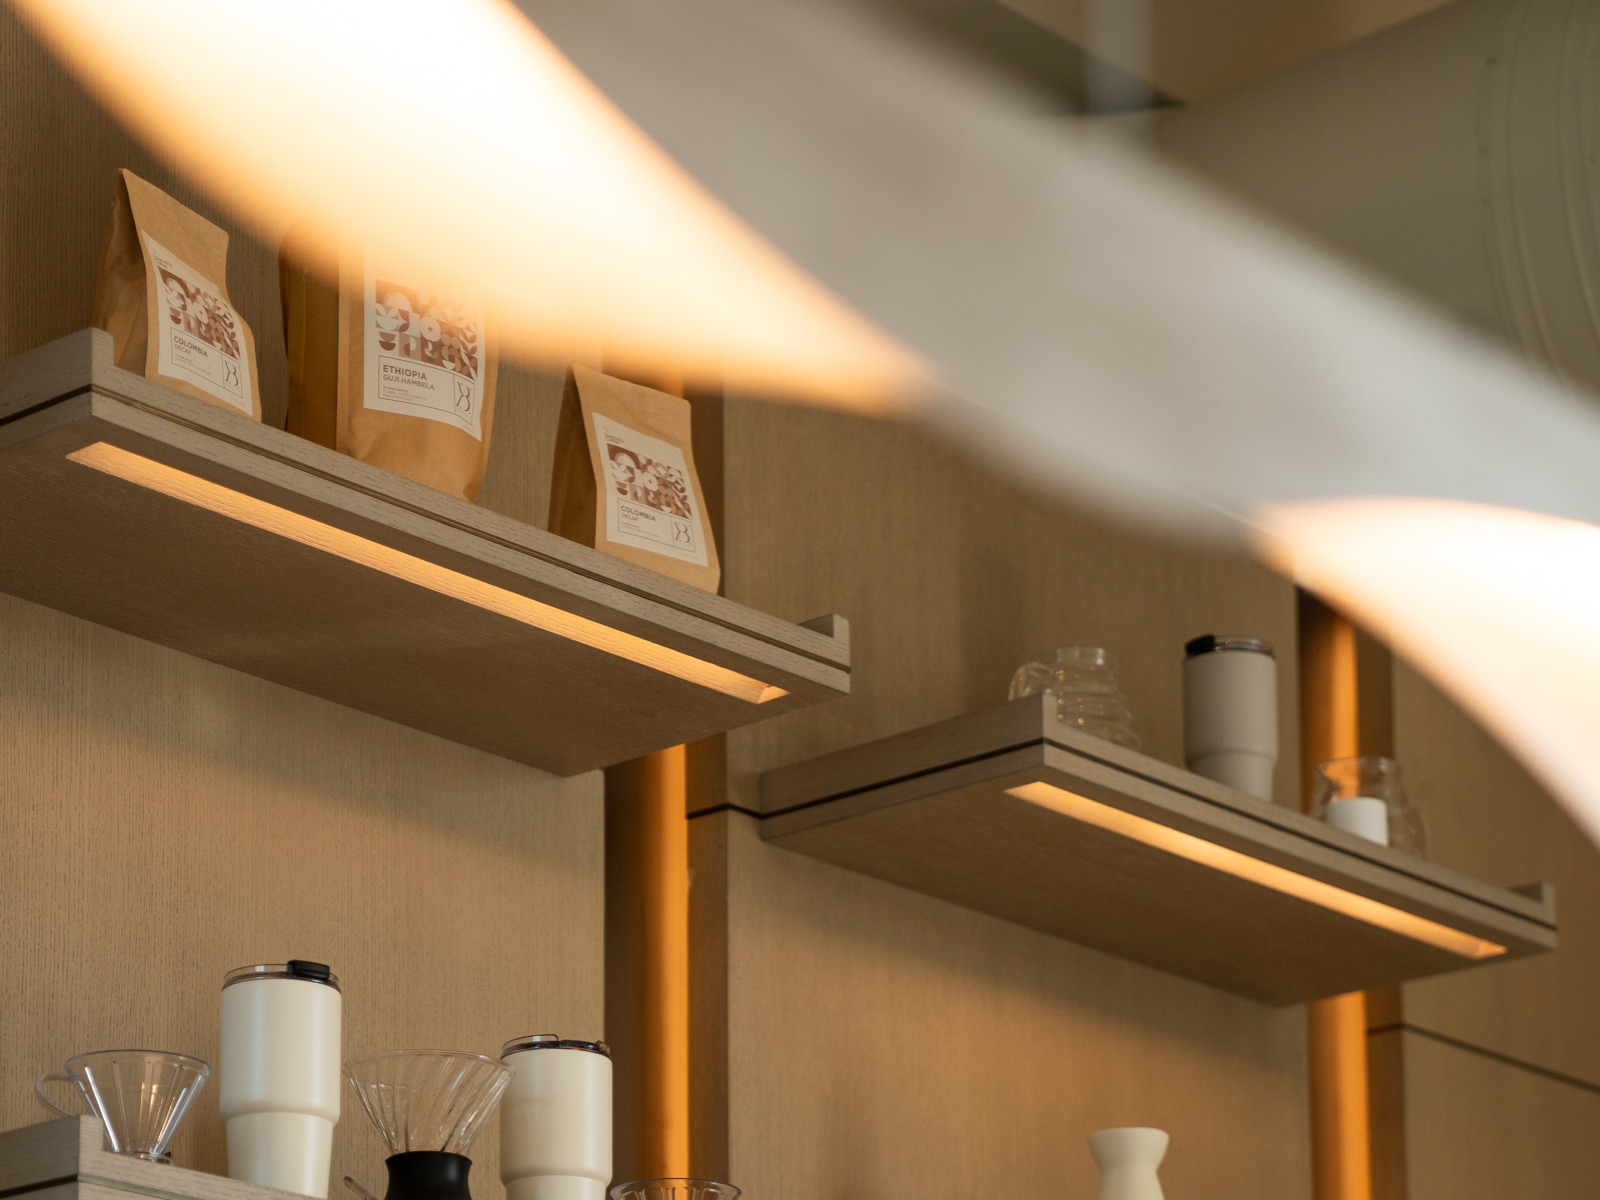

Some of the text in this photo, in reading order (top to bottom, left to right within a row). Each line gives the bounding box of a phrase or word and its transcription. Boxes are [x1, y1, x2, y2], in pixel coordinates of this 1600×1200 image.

[173, 336, 208, 358] COLOMBIA
[383, 365, 427, 380] ETHIOPIA
[383, 374, 435, 390] GUJI HAMBELA
[620, 505, 656, 522] COLOMBIA
